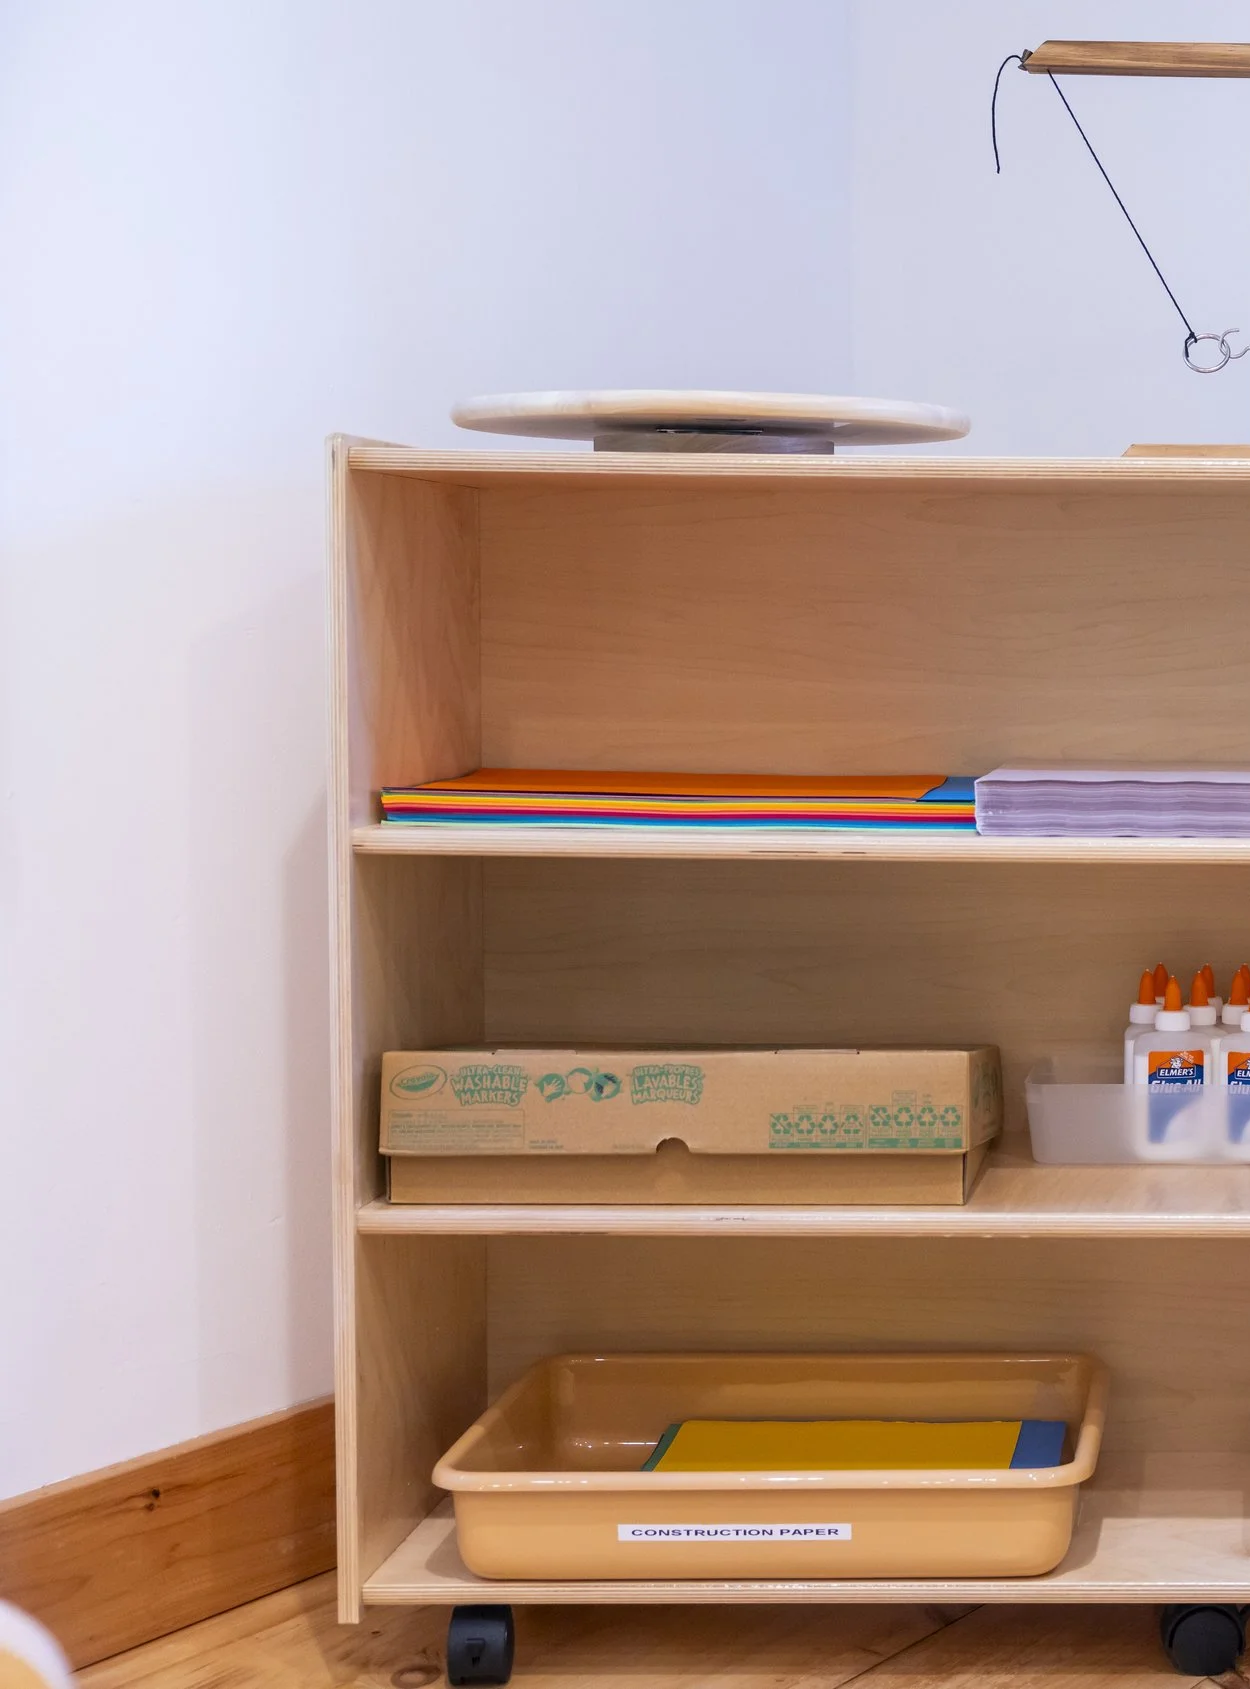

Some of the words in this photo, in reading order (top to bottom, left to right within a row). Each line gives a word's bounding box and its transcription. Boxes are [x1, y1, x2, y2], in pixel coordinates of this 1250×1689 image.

[1159, 1068, 1194, 1077] ELMER'S
[452, 1075, 528, 1091] WASHABLE
[634, 1075, 699, 1090] LAVABLES
[460, 1090, 520, 1105] MARKERS
[632, 1088, 699, 1104] MARQUEURS
[631, 1528, 773, 1537] CONSTRUCTION
[779, 1528, 839, 1537] PAPER
